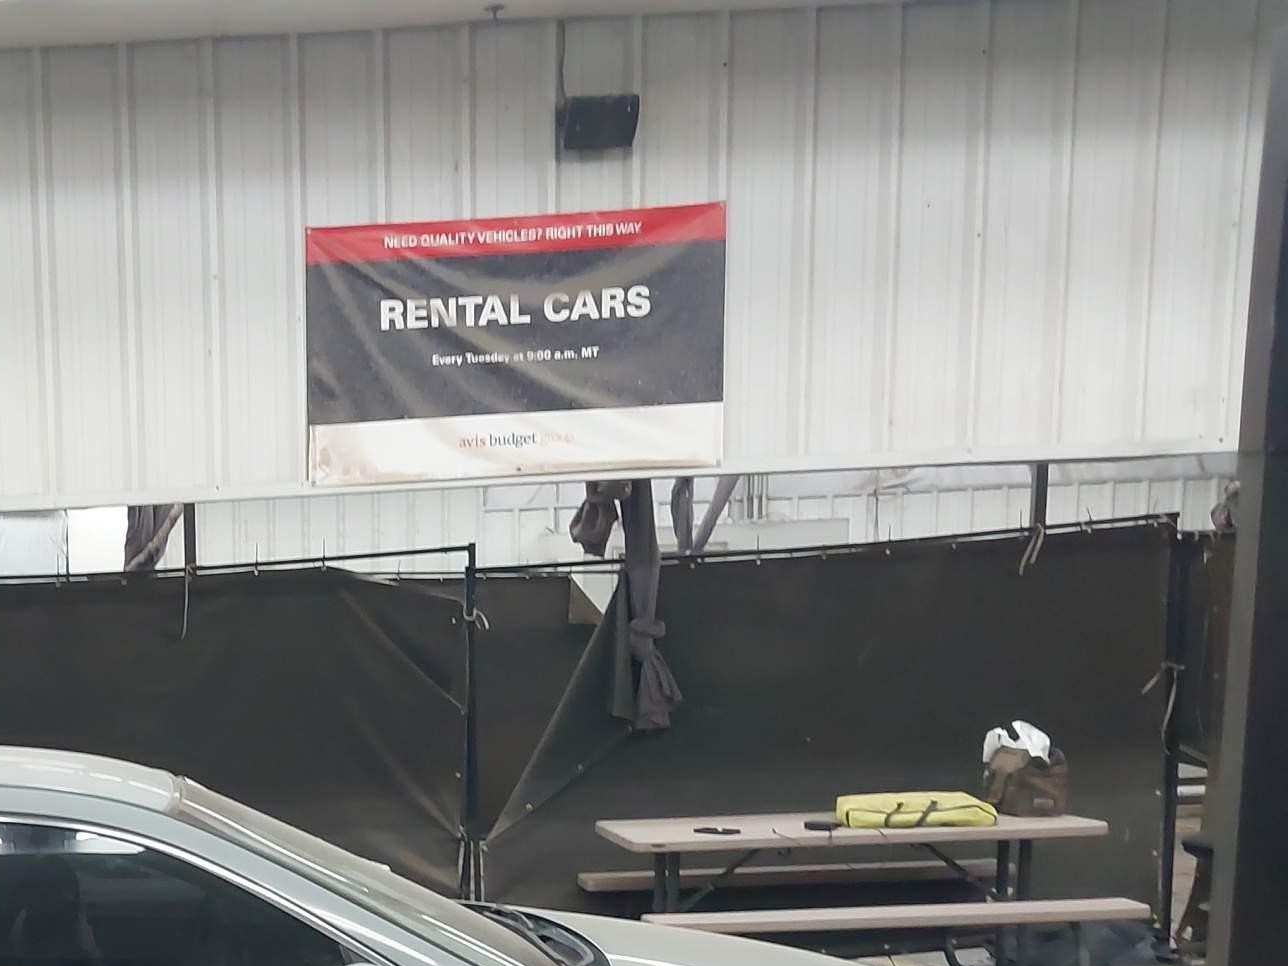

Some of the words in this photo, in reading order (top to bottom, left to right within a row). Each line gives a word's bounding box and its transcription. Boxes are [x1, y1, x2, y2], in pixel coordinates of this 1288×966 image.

[384, 235, 417, 249] NEED
[420, 232, 475, 248] QUALITY
[477, 228, 542, 245] VEHICLES?
[546, 226, 583, 241] RIGHT
[586, 224, 614, 238] THIS
[616, 221, 642, 236] WAY
[380, 294, 531, 331] RENTAL
[543, 285, 651, 322] CARS
[432, 353, 462, 366] Every
[465, 351, 509, 364] Tuesday
[512, 352, 524, 362] at
[581, 346, 600, 358] MT
[459, 434, 486, 449] avis
[489, 432, 537, 449] budget
